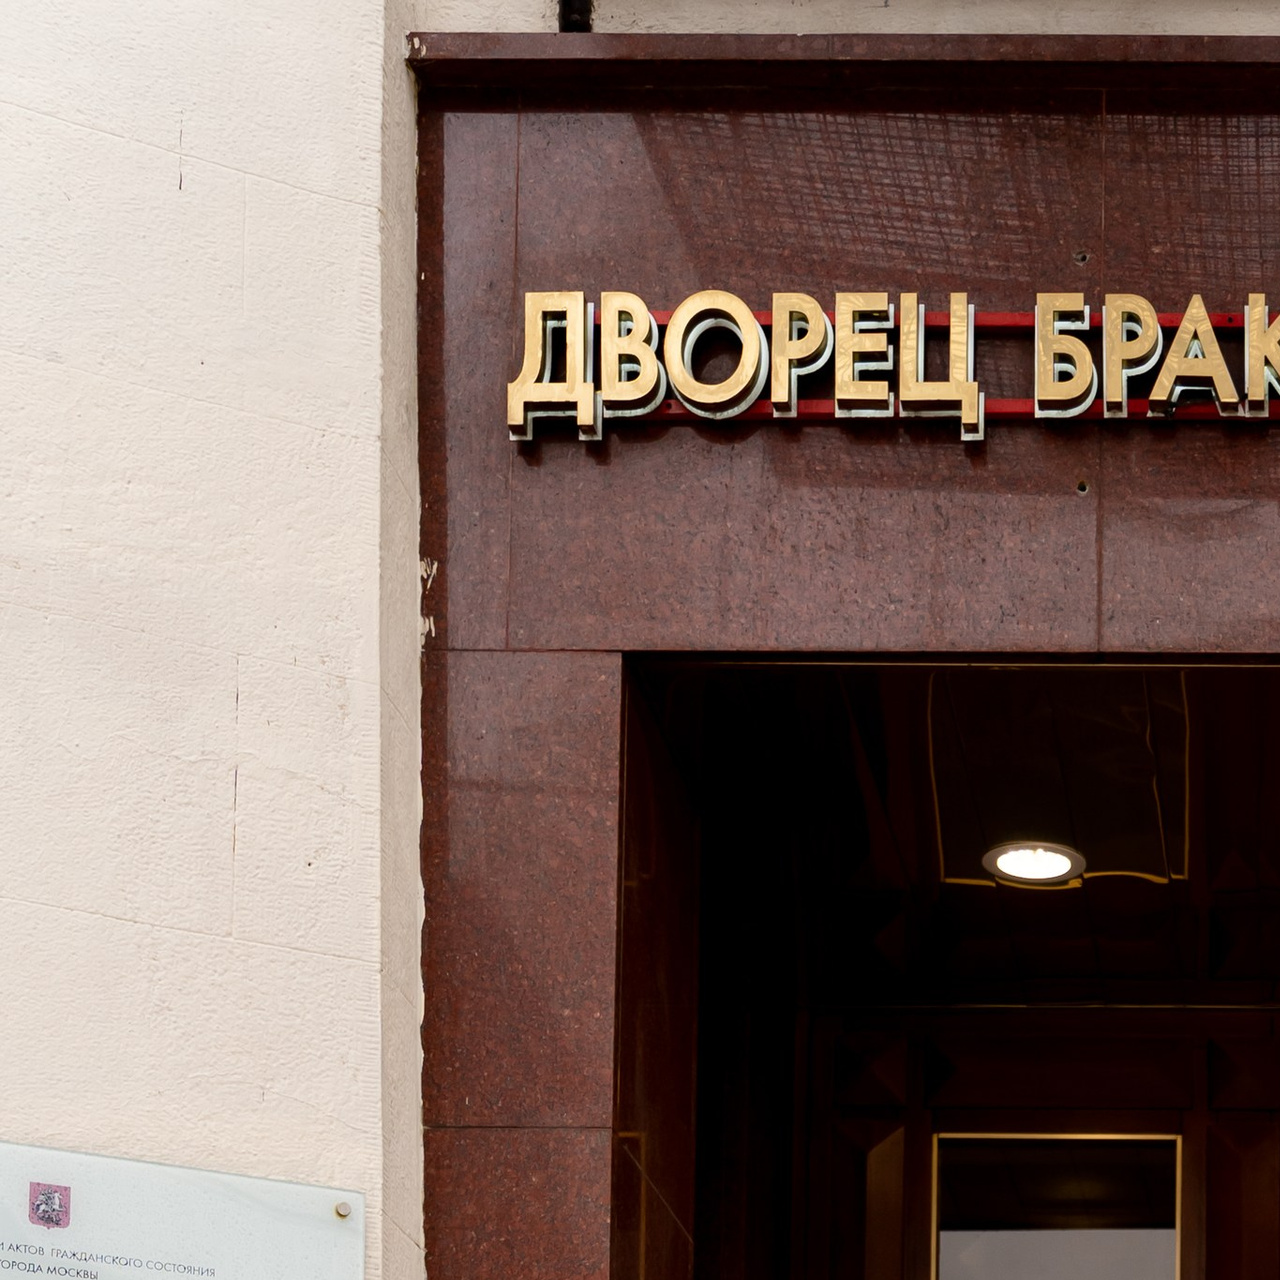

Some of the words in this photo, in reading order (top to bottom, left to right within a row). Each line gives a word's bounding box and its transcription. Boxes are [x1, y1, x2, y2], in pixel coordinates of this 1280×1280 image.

[507, 290, 986, 441] ДВОРЕЦ
[0, 1259, 43, 1274] ОРОДА
[46, 1266, 99, 1280] МОСКВЫ
[7, 1243, 45, 1256] АКТОВ
[50, 1248, 143, 1268] ГРАЖДАНСКОГО
[145, 1260, 216, 1277] СОСТОЯНИЯ
